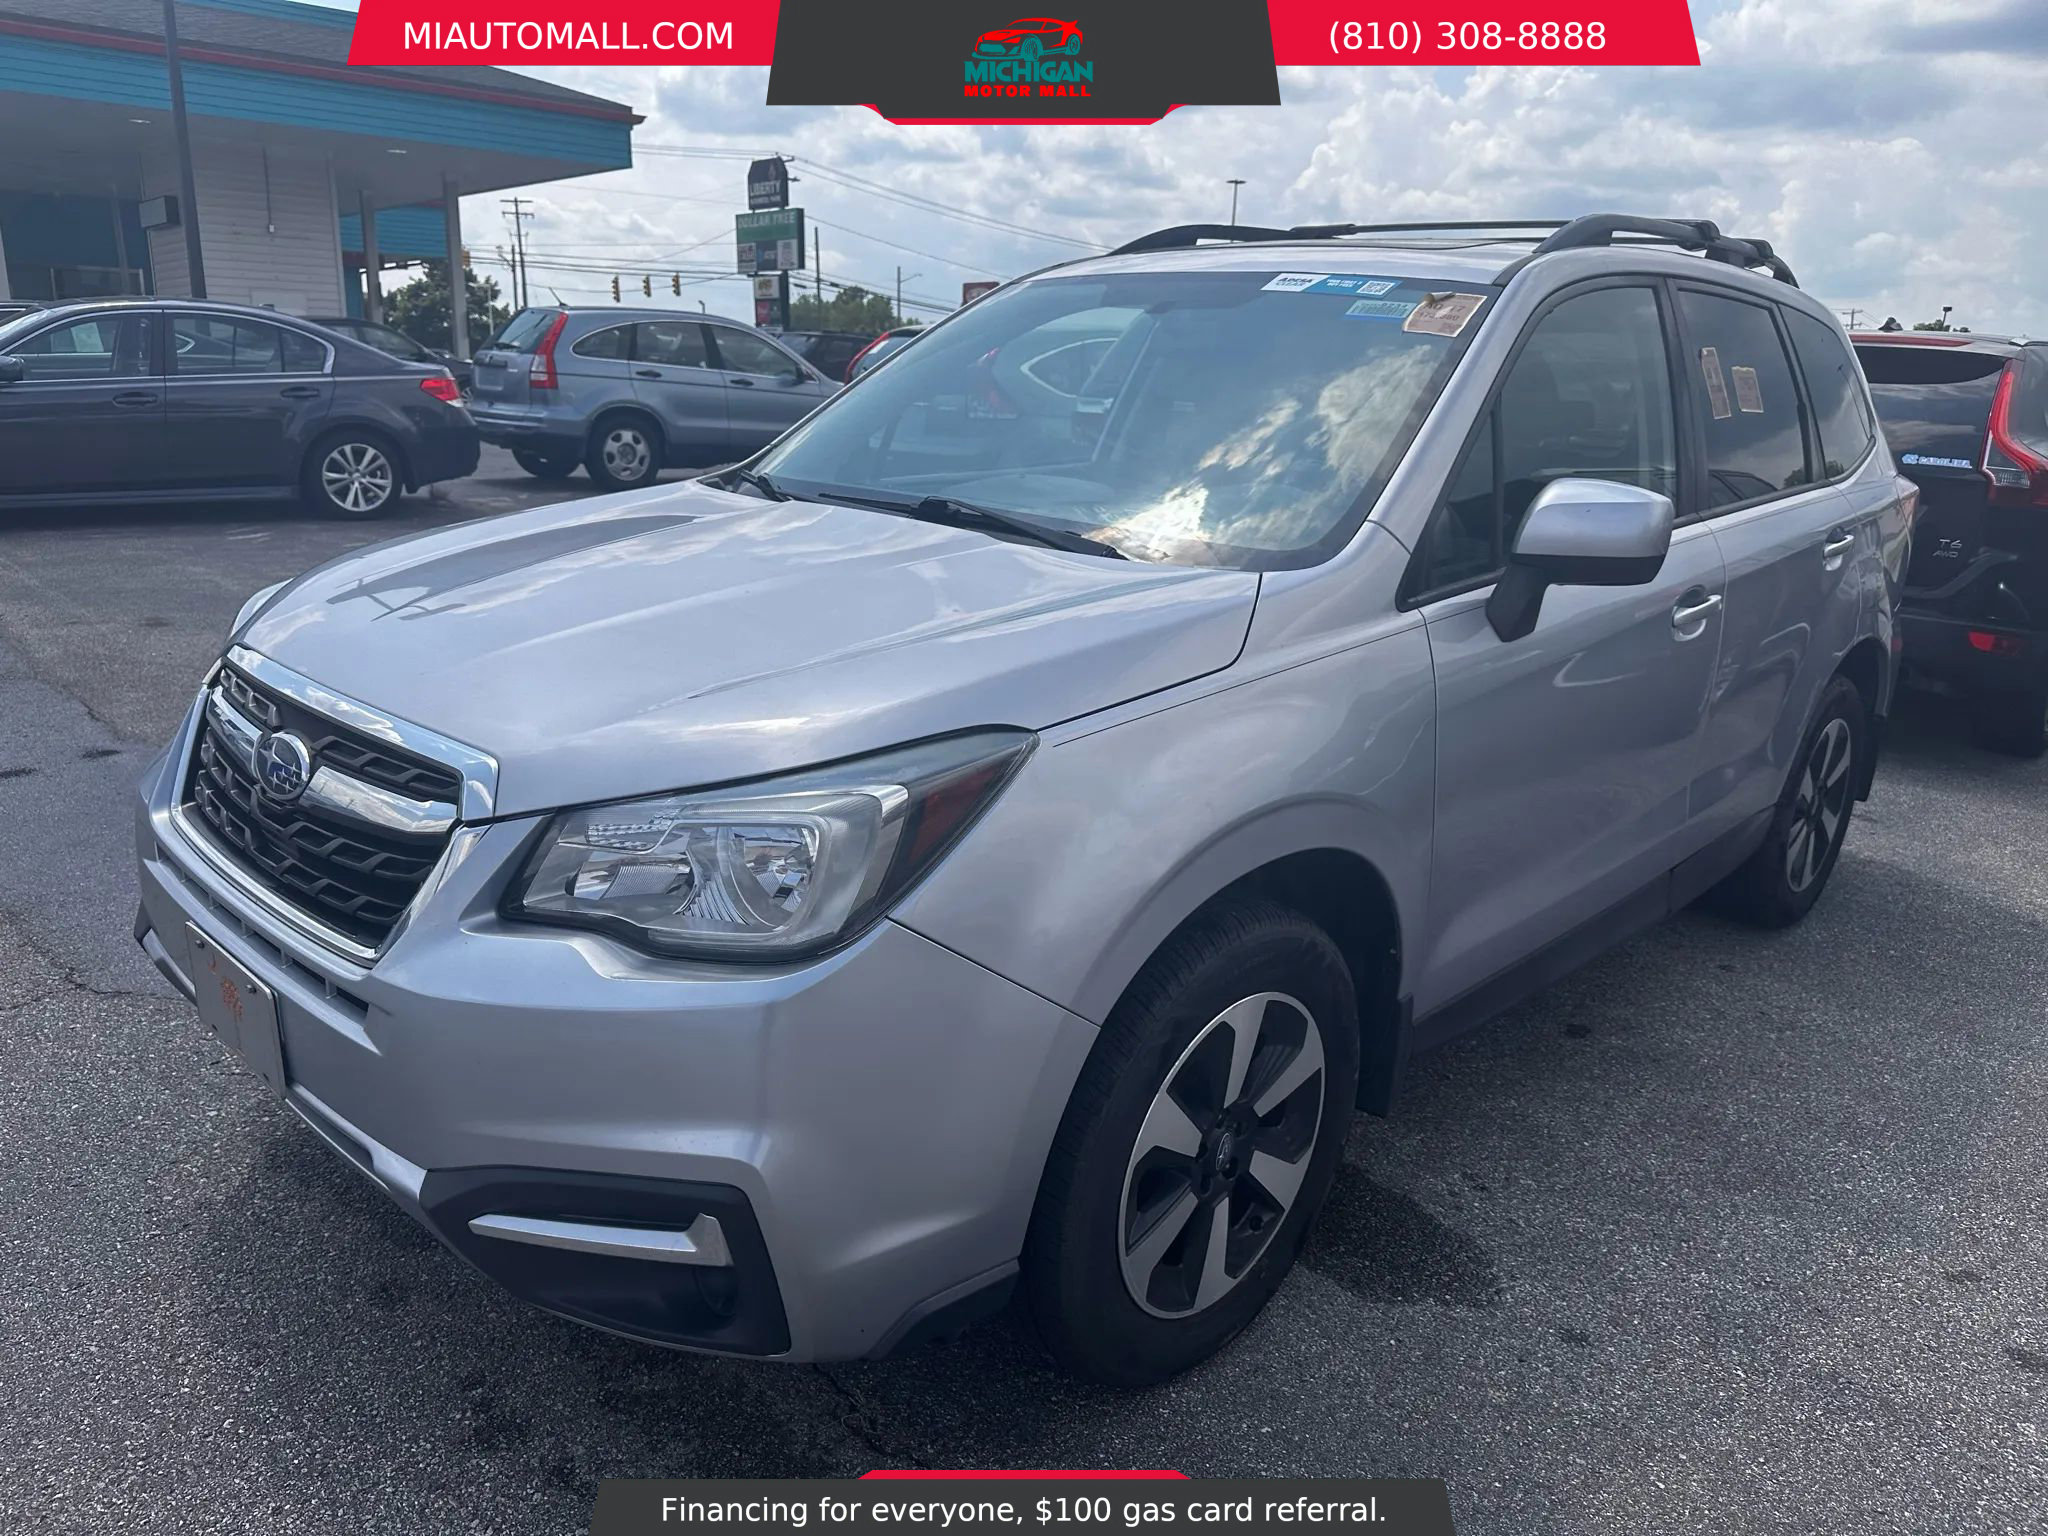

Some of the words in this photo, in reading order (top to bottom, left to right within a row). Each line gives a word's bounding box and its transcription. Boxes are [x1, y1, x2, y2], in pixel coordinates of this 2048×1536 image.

[750, 180, 780, 196] LIBERTY
[738, 214, 769, 229] DOLLAR
[771, 211, 796, 225] TREE
[1939, 538, 1963, 549] T6
